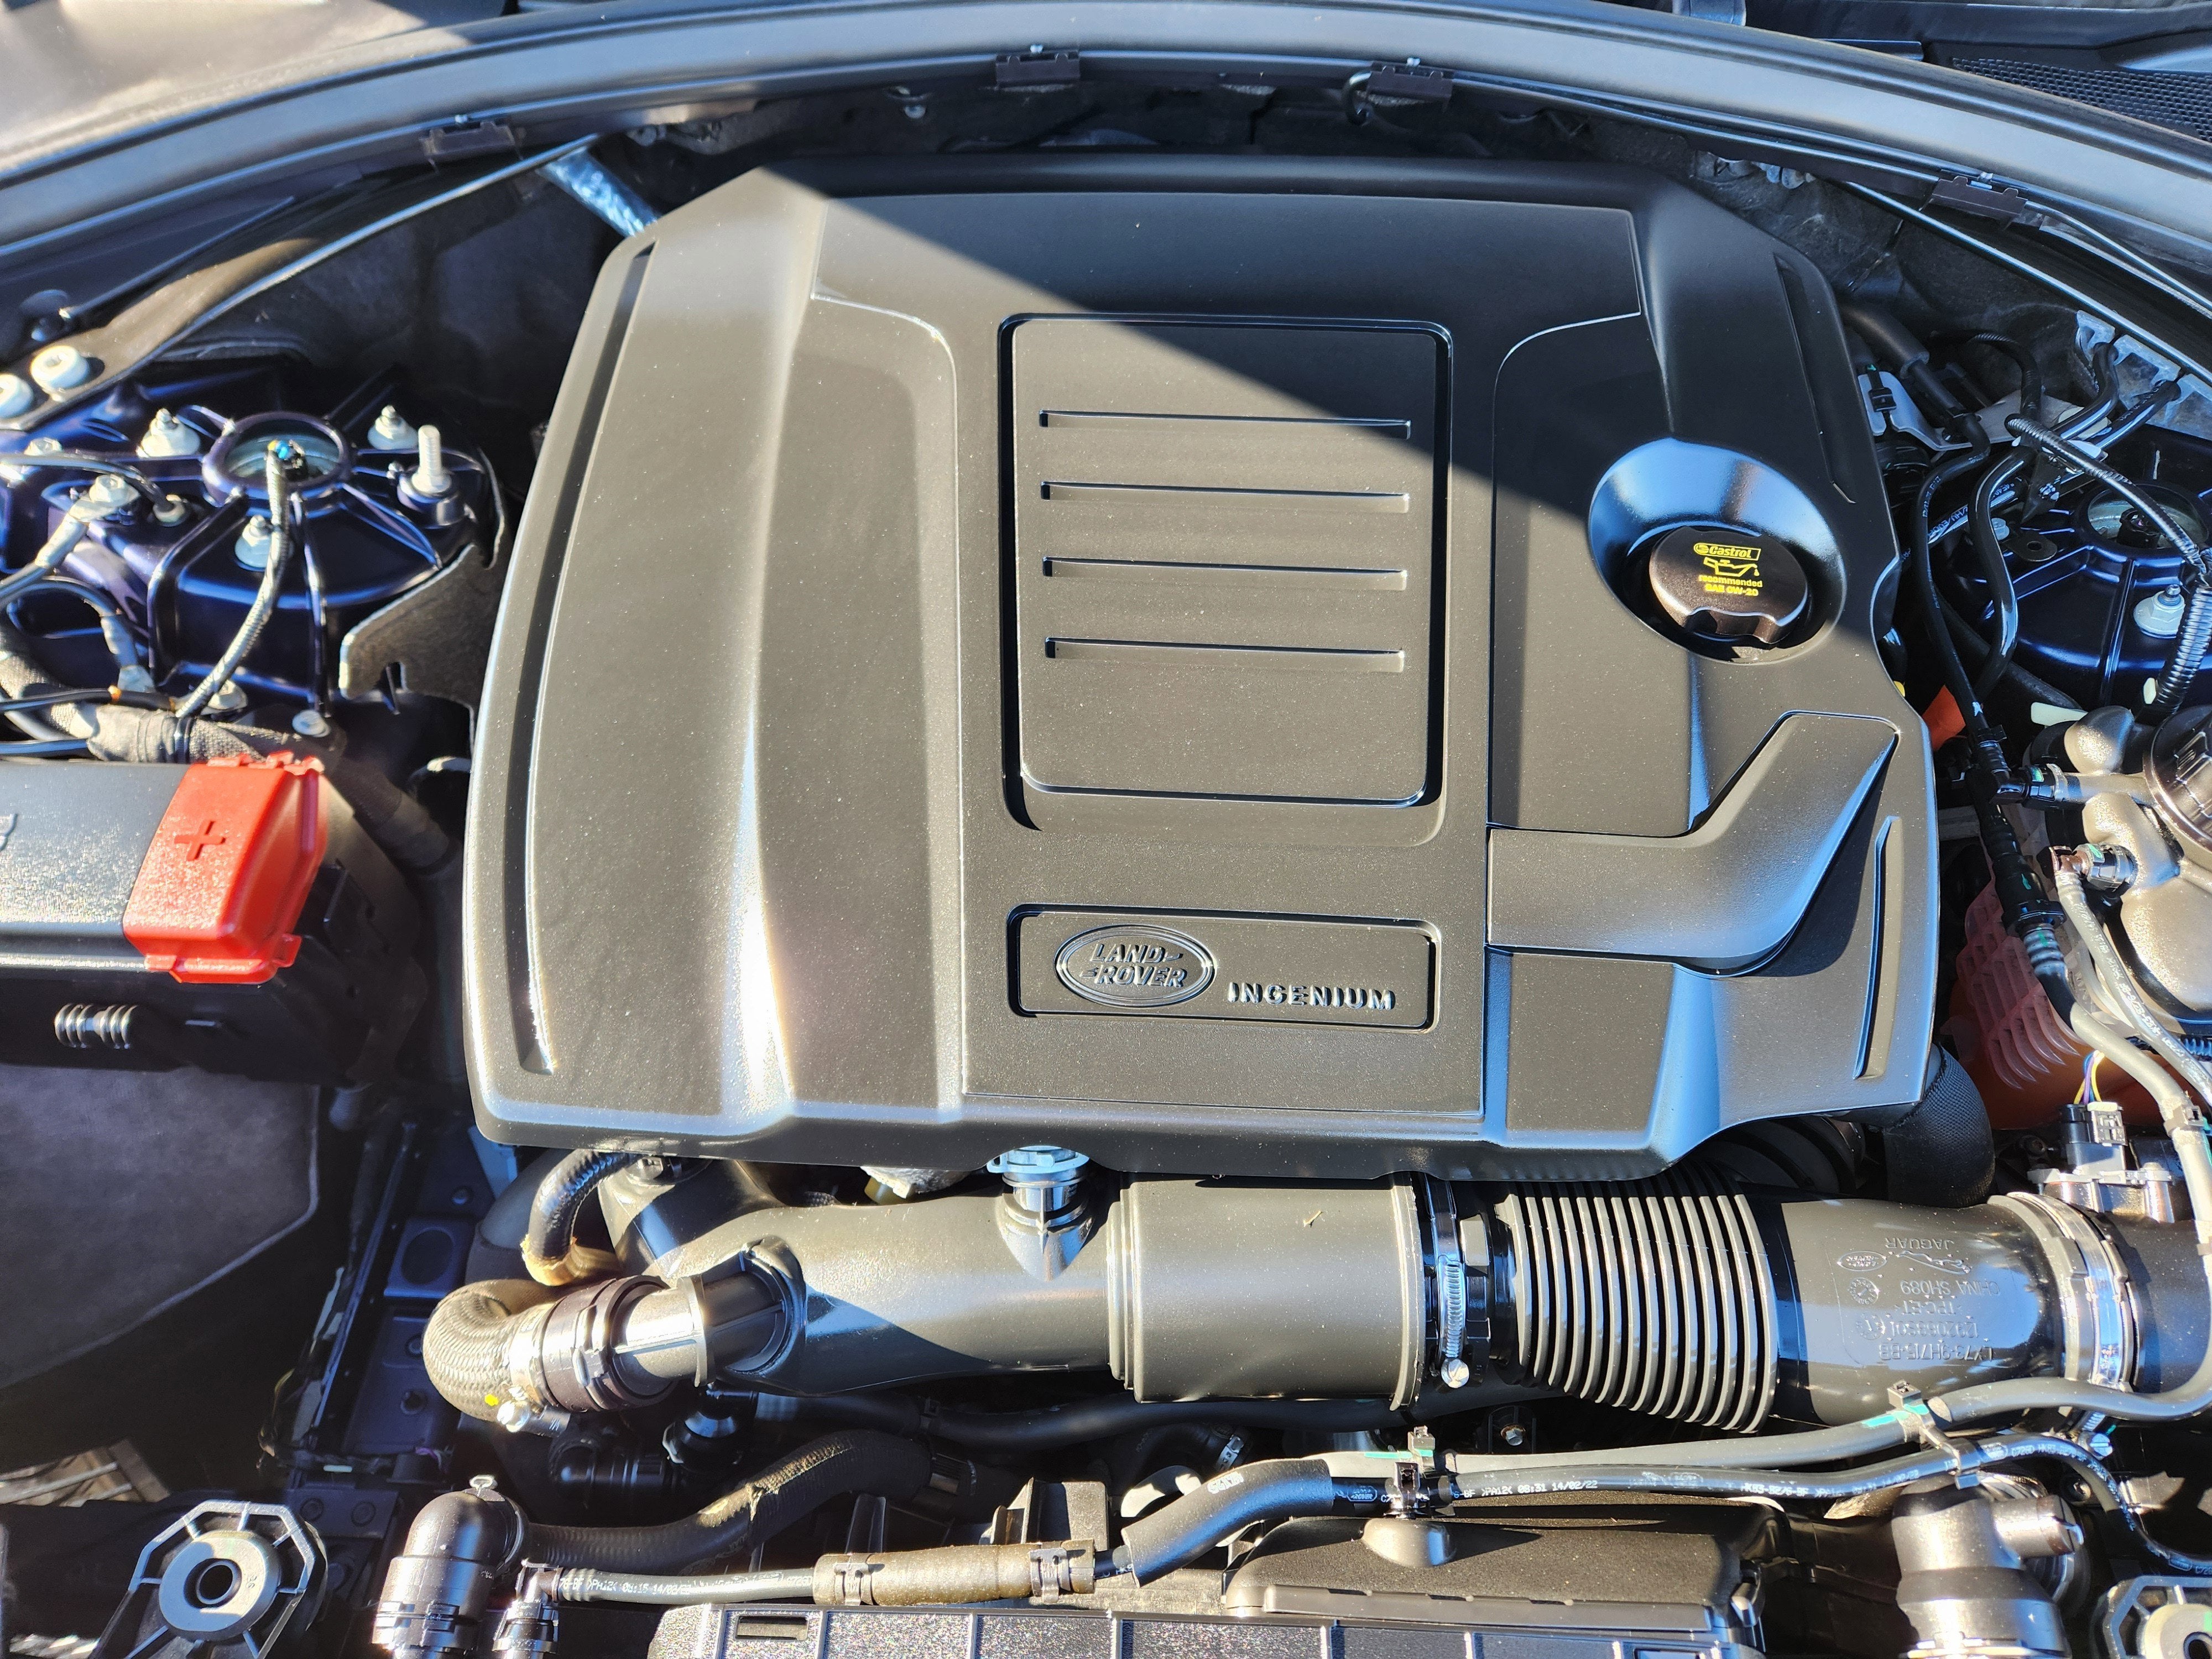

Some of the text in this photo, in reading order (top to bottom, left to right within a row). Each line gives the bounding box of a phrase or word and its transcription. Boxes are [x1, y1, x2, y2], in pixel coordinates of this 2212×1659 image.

[1709, 545, 1752, 559] Castrol
[1698, 575, 1763, 587] recommended
[1704, 583, 1759, 597] SAE 0W-20
[1228, 982, 1396, 1010] INGENIUM
[1885, 1237, 1955, 1250] JAGUAR
[1900, 1280, 2001, 1296] CHINA SH089
